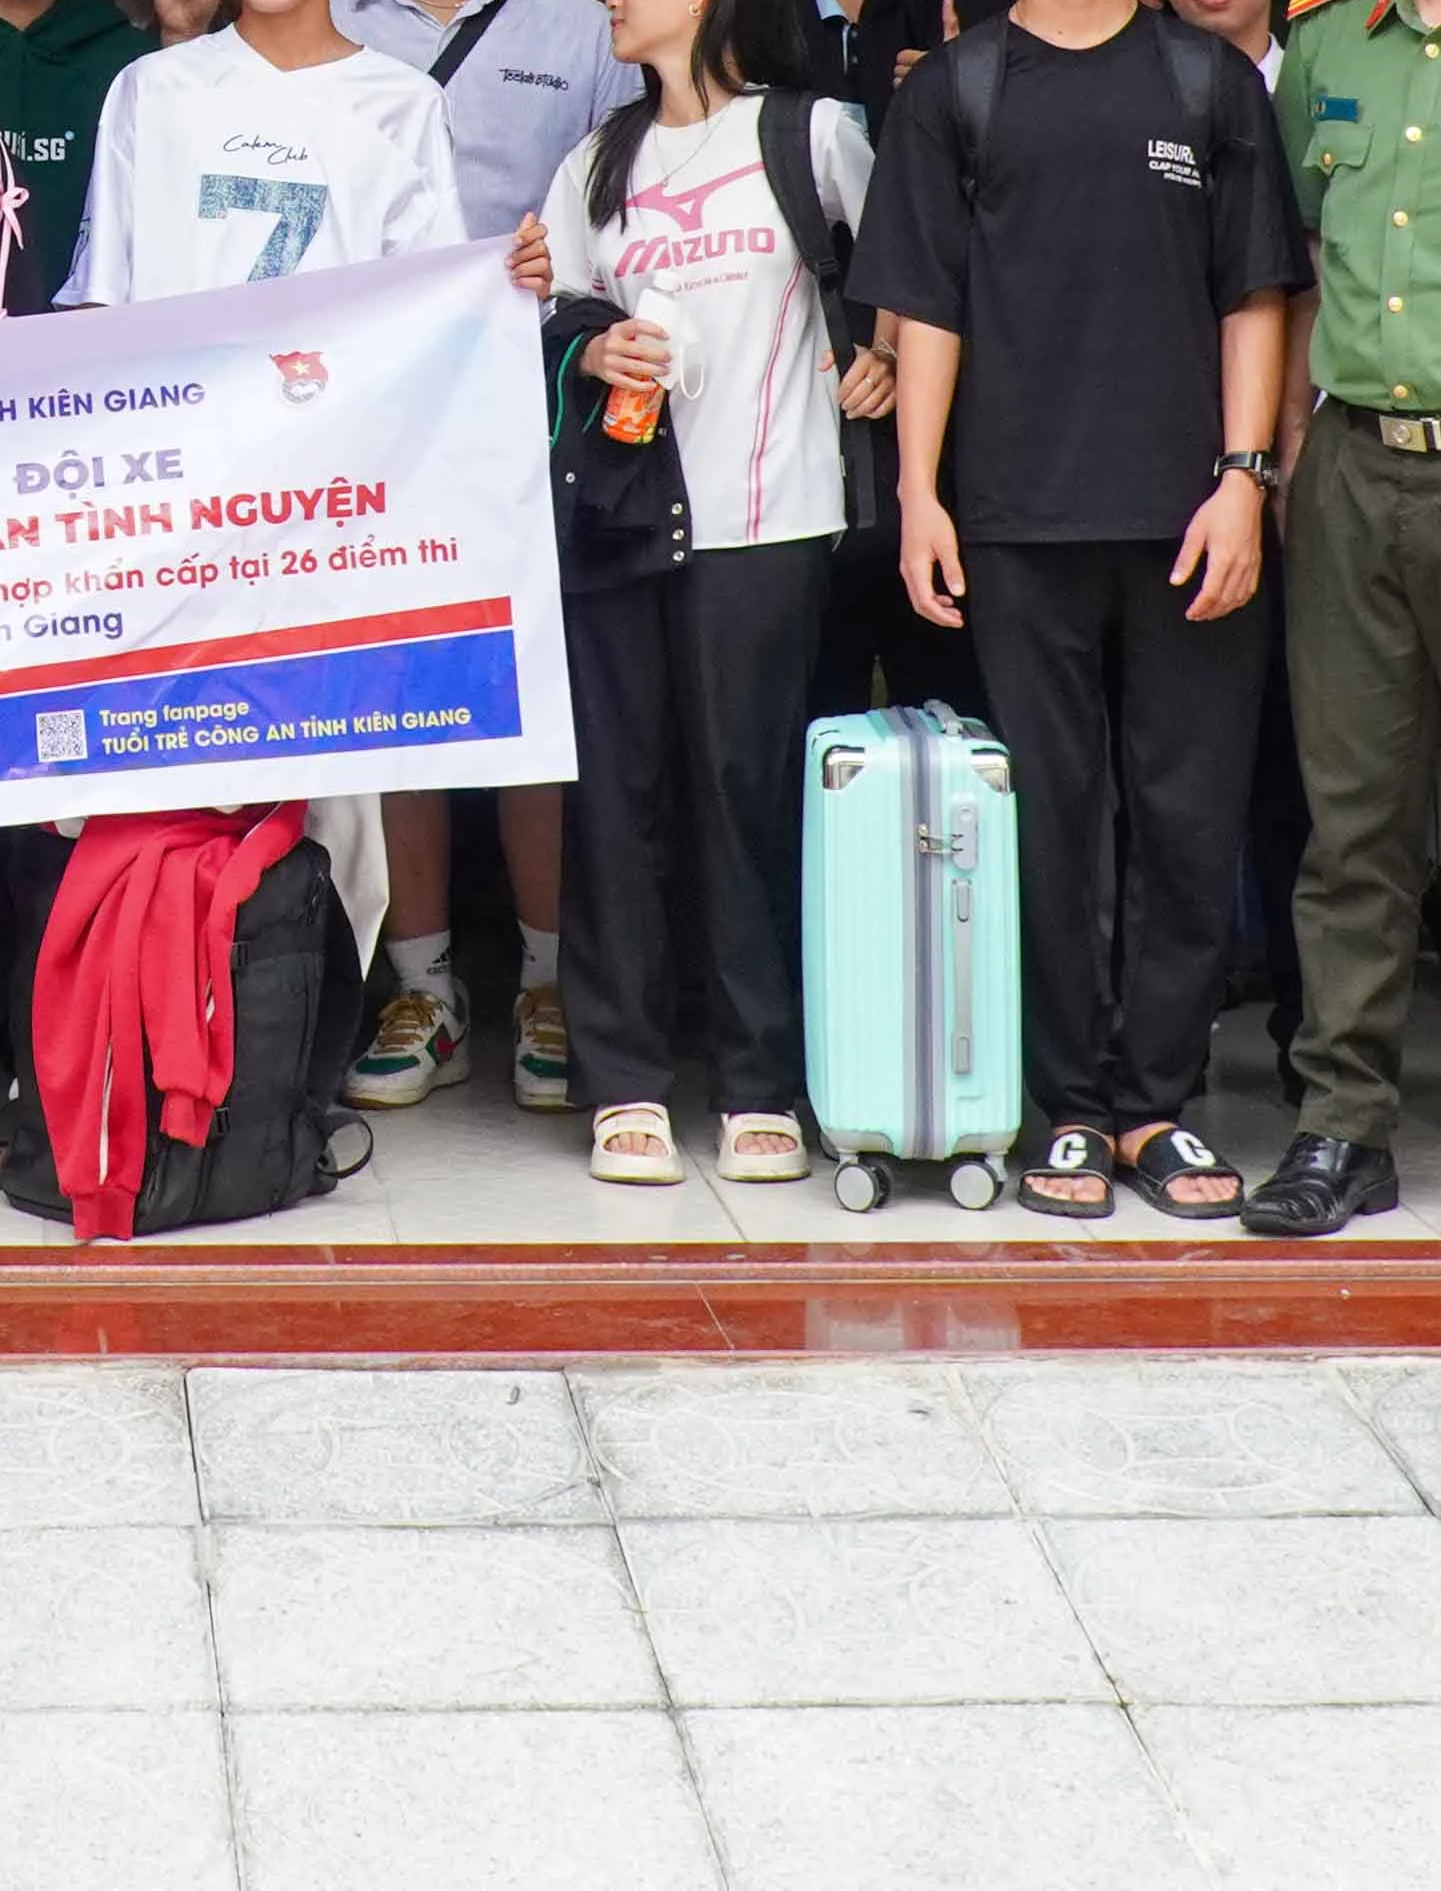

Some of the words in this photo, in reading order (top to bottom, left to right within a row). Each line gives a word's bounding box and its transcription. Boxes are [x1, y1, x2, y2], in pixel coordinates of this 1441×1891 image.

[198, 174, 328, 283] 7
[27, 388, 94, 419] KIÊN
[103, 382, 205, 412] GIANG
[13, 450, 105, 500] ĐỘI
[122, 448, 183, 484] XE
[56, 501, 173, 544] TÌNH
[191, 477, 387, 529] NGUYỆN
[66, 557, 145, 594] khẩn
[156, 554, 220, 592] cấp
[231, 553, 271, 581] tại
[281, 550, 318, 575] 26
[329, 534, 409, 571] điểm
[419, 538, 460, 565] thi
[24, 608, 125, 640] Giang
[100, 708, 159, 730] Trang
[162, 699, 249, 726] fanpage
[102, 730, 150, 755] TUỔI
[155, 726, 189, 750] TRẺ
[195, 721, 259, 747] CÔNG
[265, 721, 296, 742] AN
[302, 712, 346, 740] TỈNH
[352, 709, 397, 734] KIÊN
[402, 708, 471, 730] GIANG
[1048, 1132, 1088, 1169] G
[1170, 1130, 1217, 1167] G
